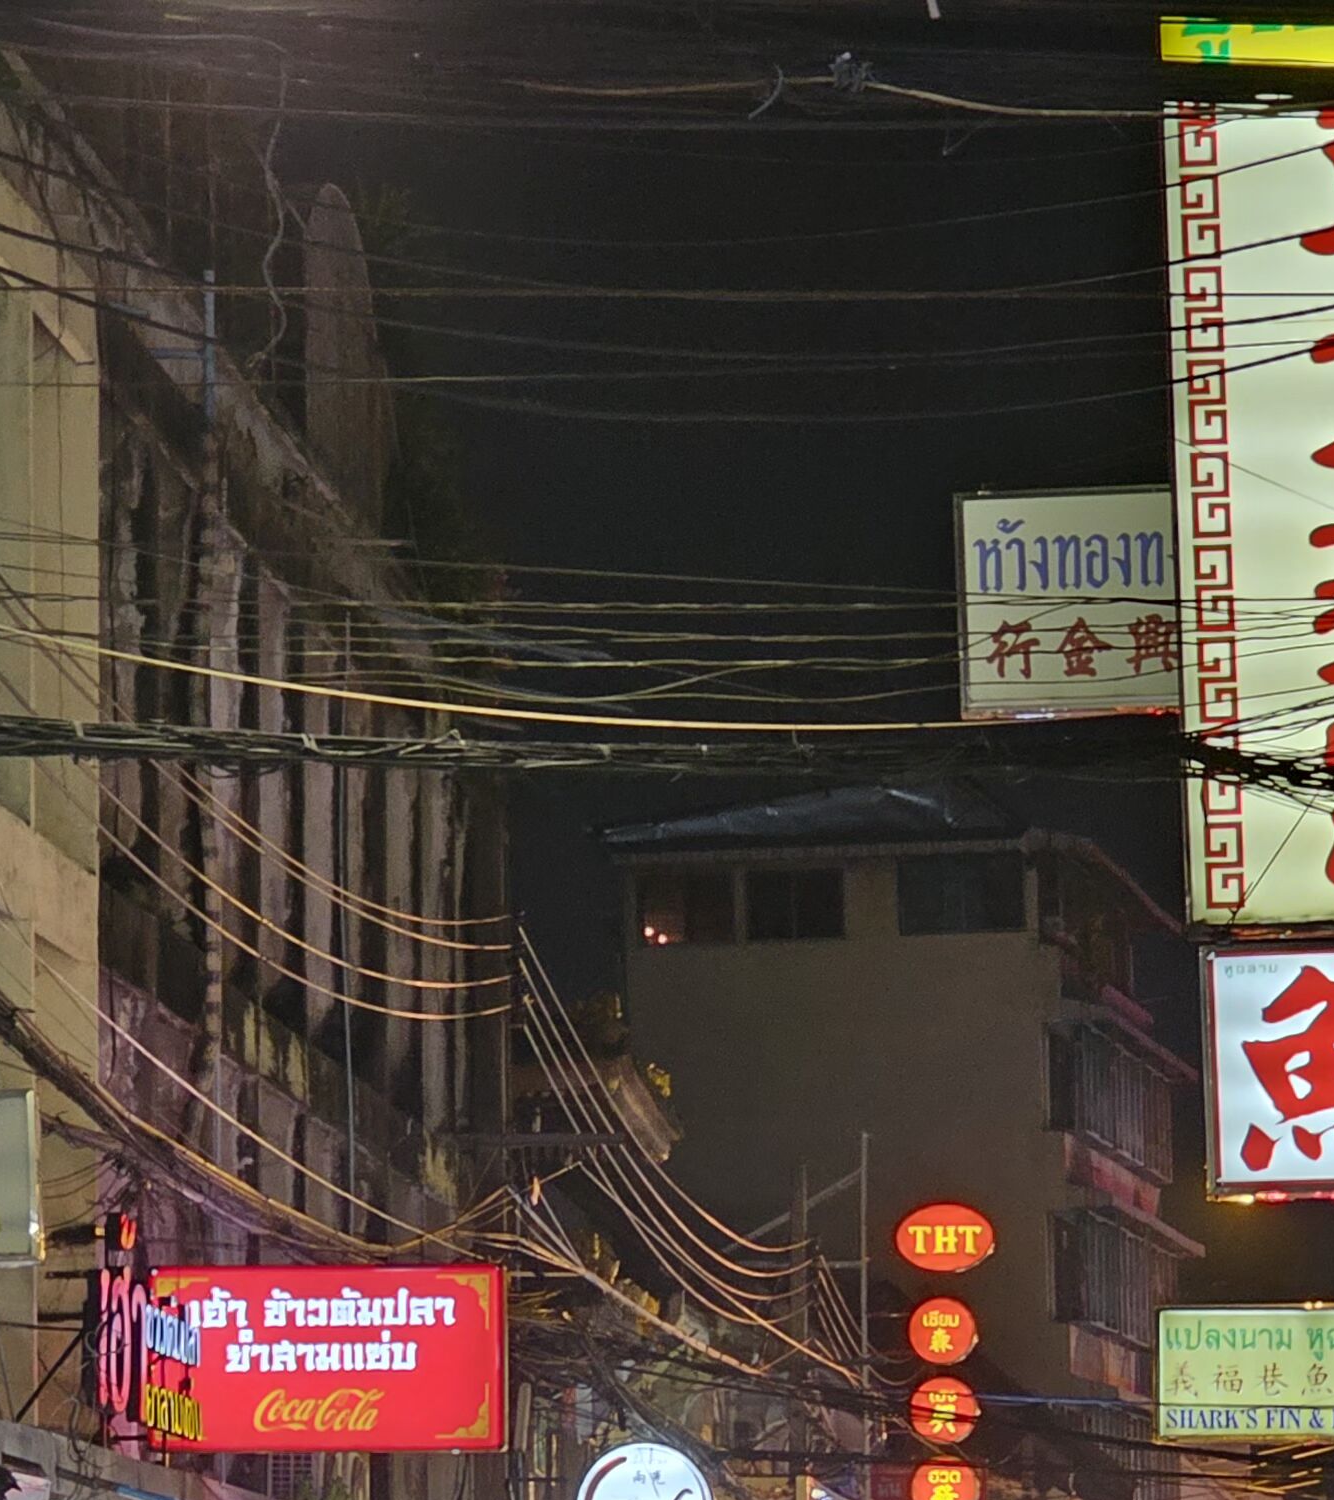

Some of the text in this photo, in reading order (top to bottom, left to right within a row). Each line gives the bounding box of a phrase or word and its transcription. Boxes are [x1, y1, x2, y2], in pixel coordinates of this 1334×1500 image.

[973, 517, 1174, 592] ห้างทองท
[907, 1224, 983, 1255] THT
[263, 1286, 457, 1328] ข้าวต้มปลา
[1166, 1320, 1292, 1351] แปลงนาม
[1167, 1406, 1259, 1430] SHARK'S
[1266, 1407, 1302, 1429] FIN
[1308, 1407, 1326, 1429] &
